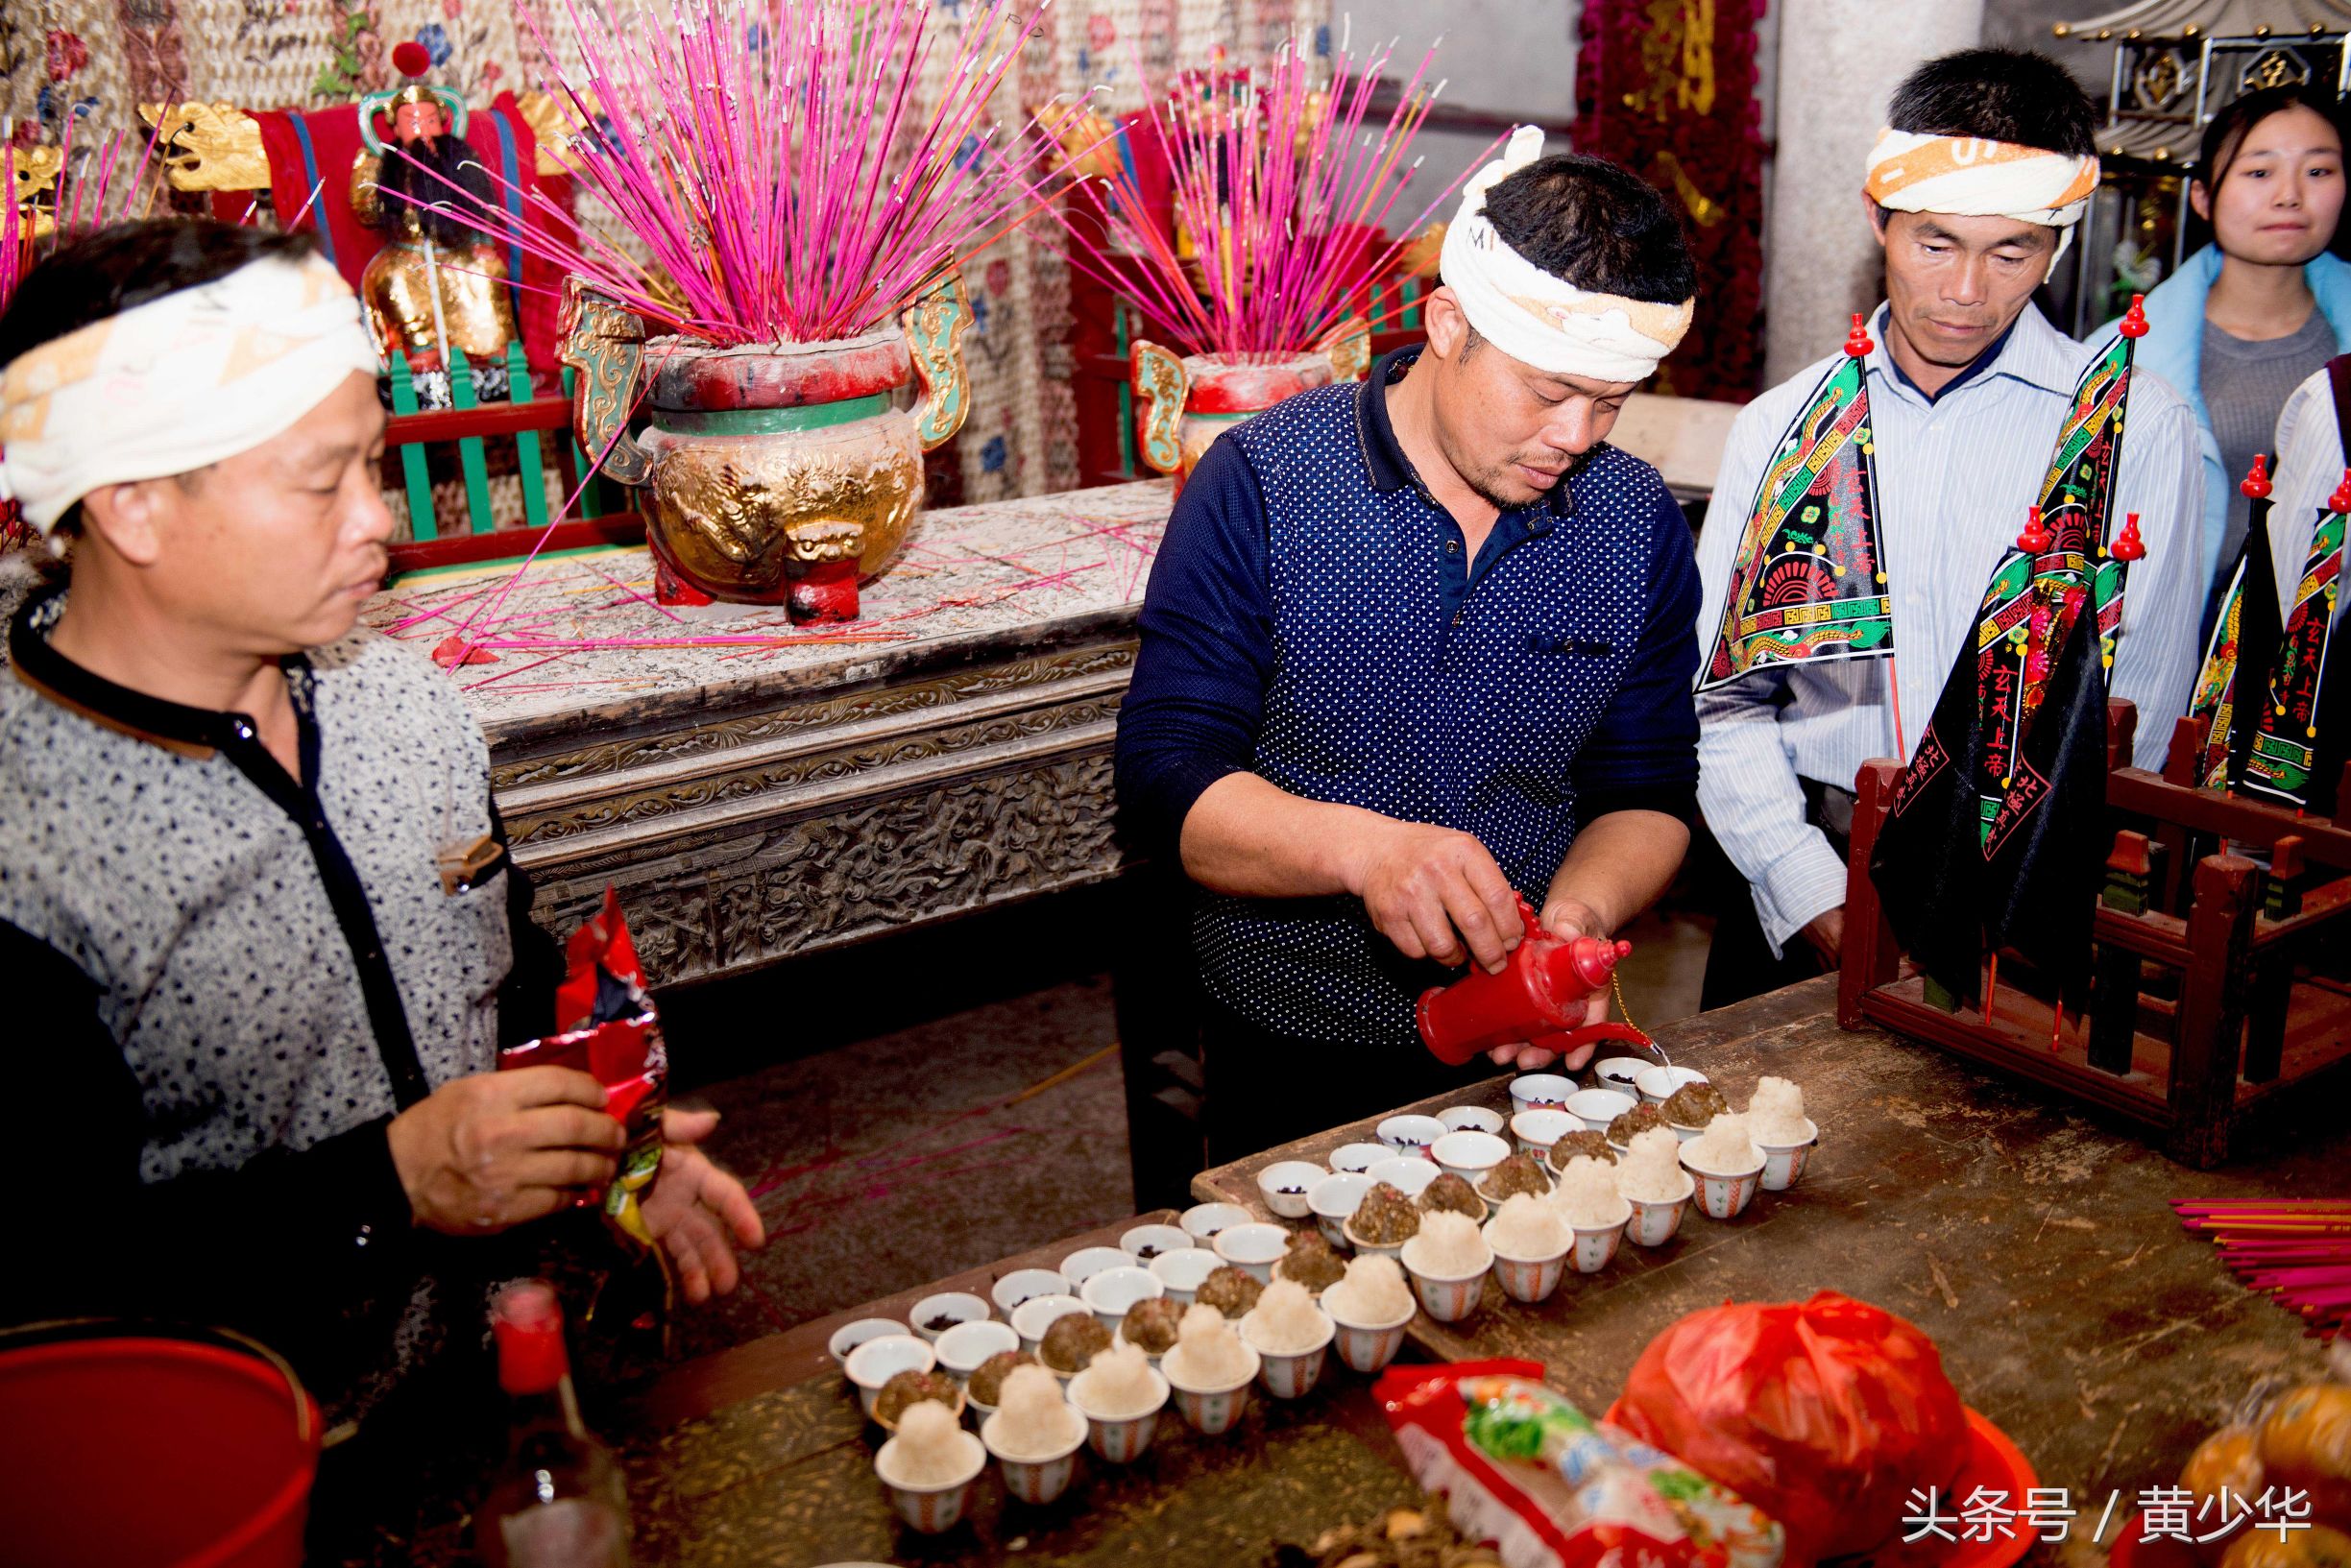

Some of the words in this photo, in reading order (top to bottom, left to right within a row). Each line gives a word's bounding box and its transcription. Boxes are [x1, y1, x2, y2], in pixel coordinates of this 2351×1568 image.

[1843, 467, 1876, 576] 玄天上帝
[1983, 664, 2019, 778] 玄天上帝
[2292, 616, 2326, 723] 玄天上帝
